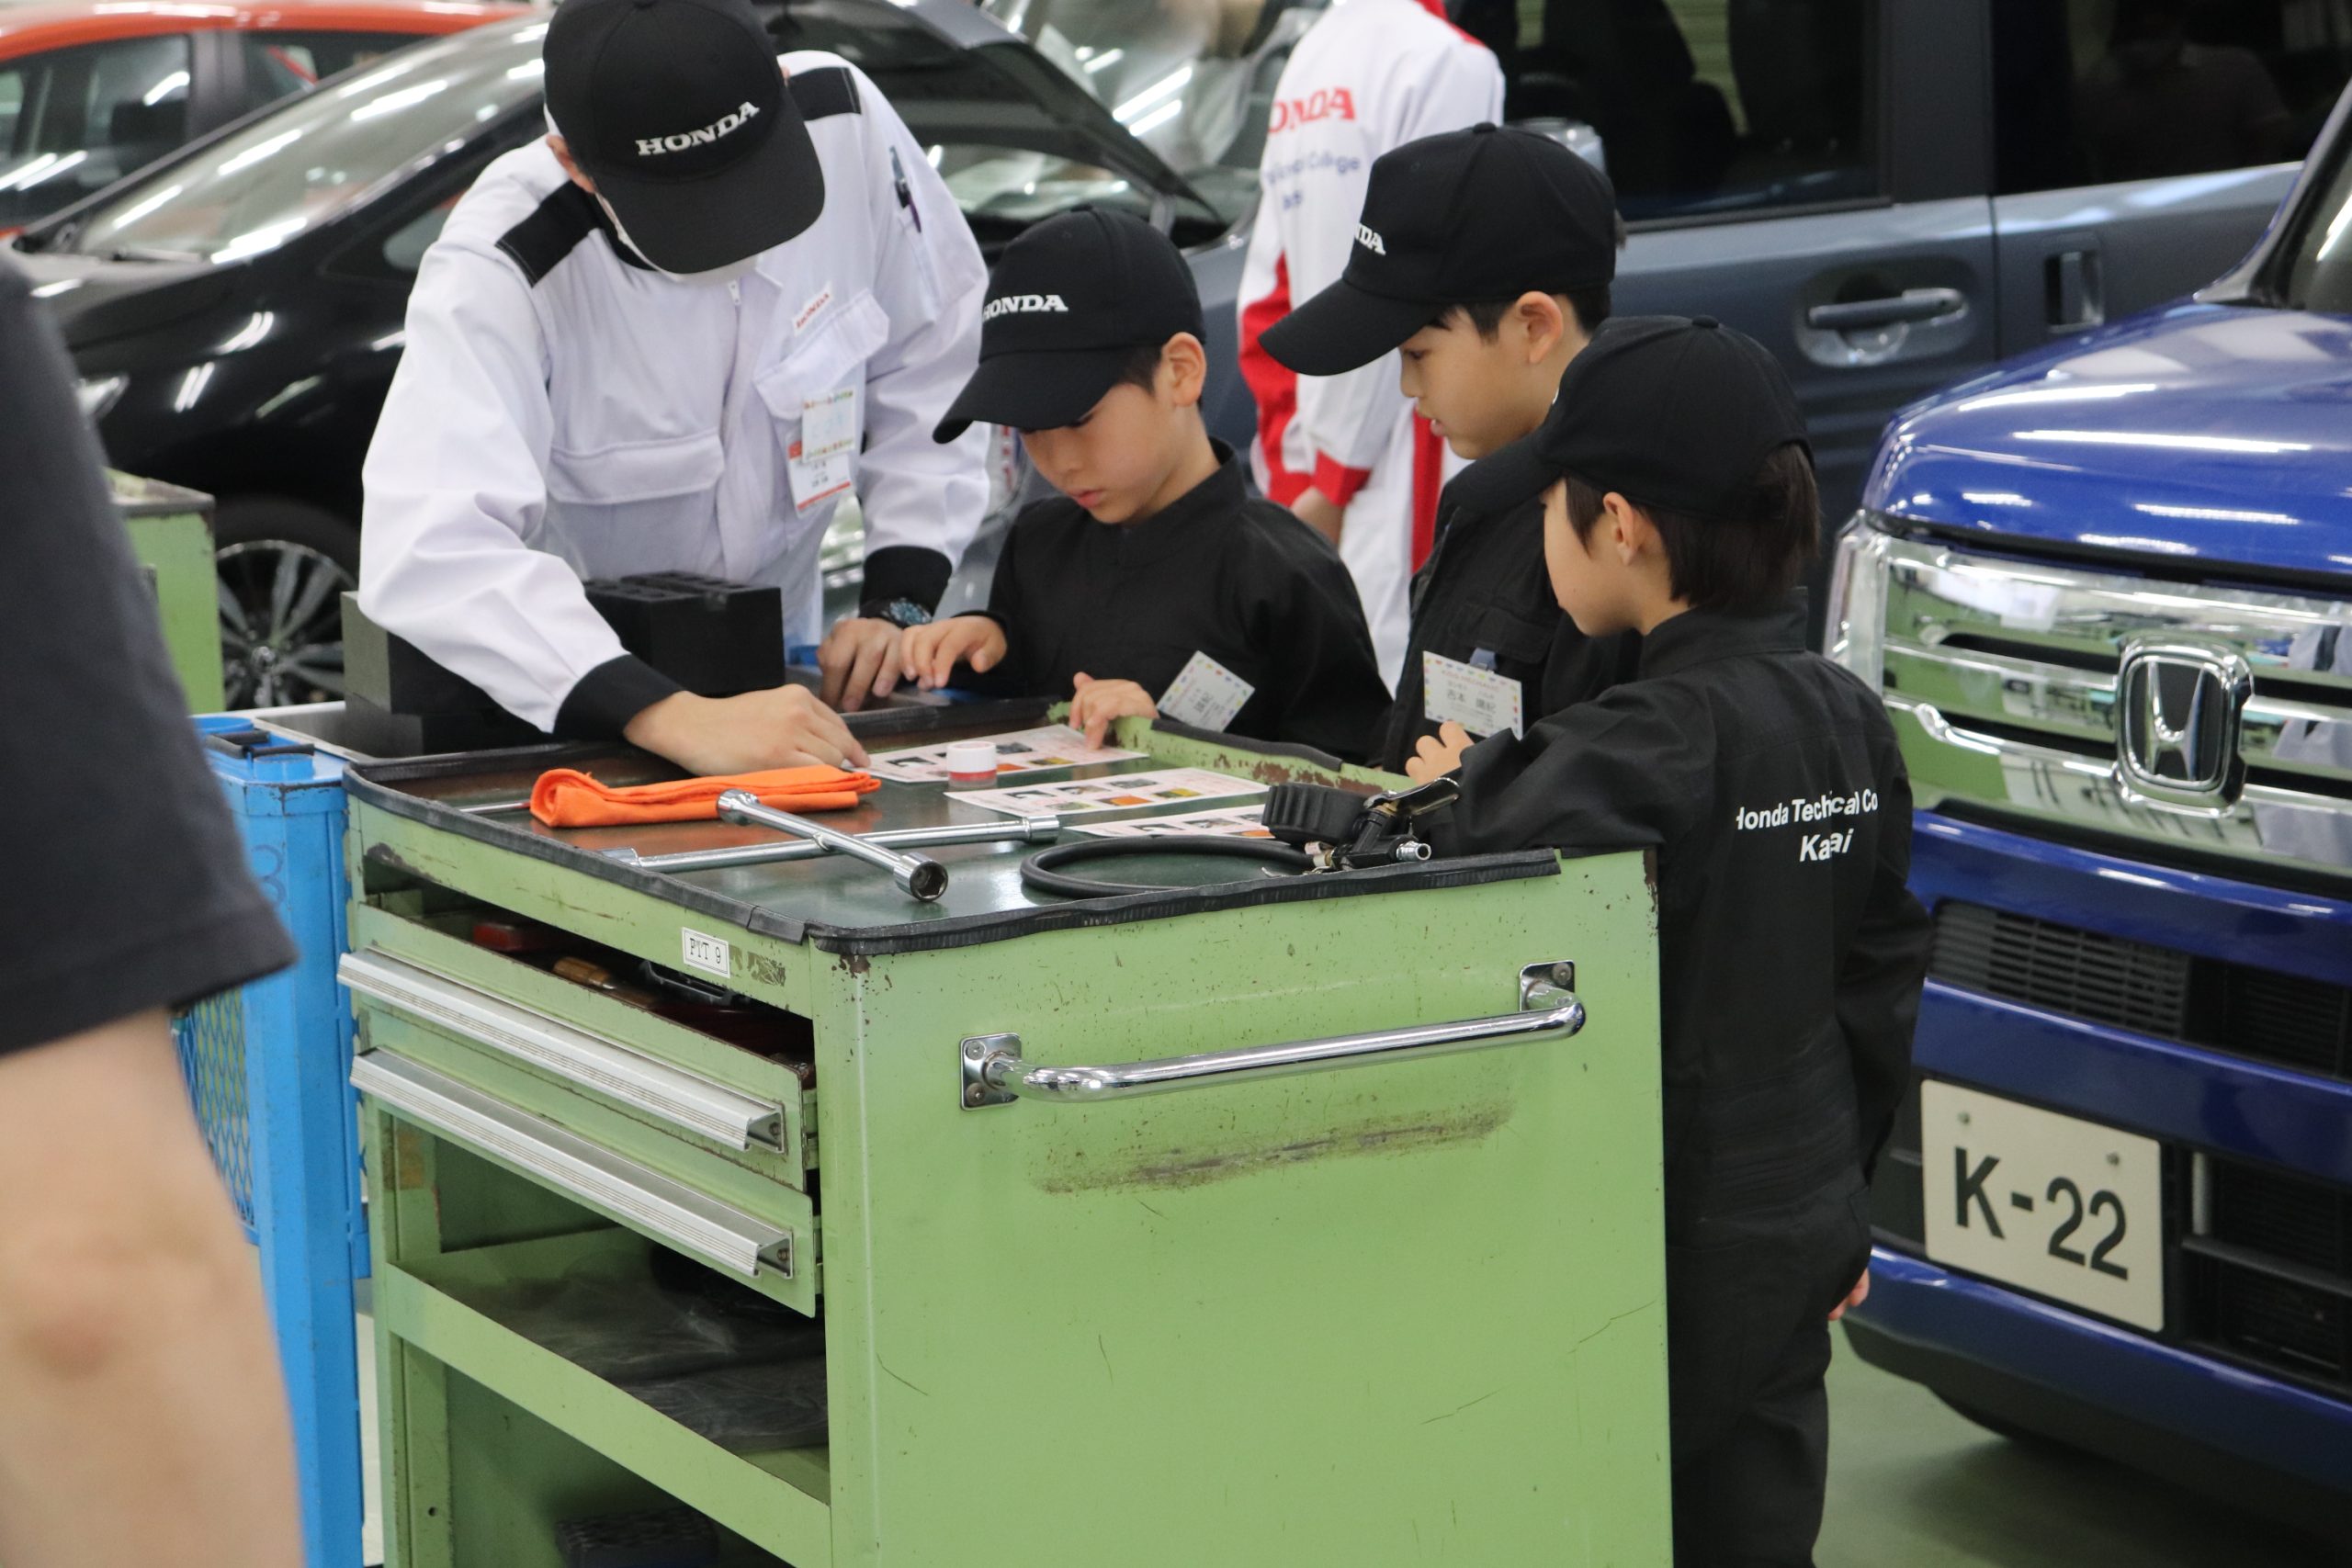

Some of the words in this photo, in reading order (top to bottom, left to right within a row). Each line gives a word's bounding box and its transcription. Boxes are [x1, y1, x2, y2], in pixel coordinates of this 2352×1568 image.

[635, 101, 760, 155] HONDA
[1268, 87, 1355, 134] ONDA
[689, 937, 709, 961] PIT
[715, 945, 721, 964] 9
[1955, 1145, 2129, 1281] K-22
